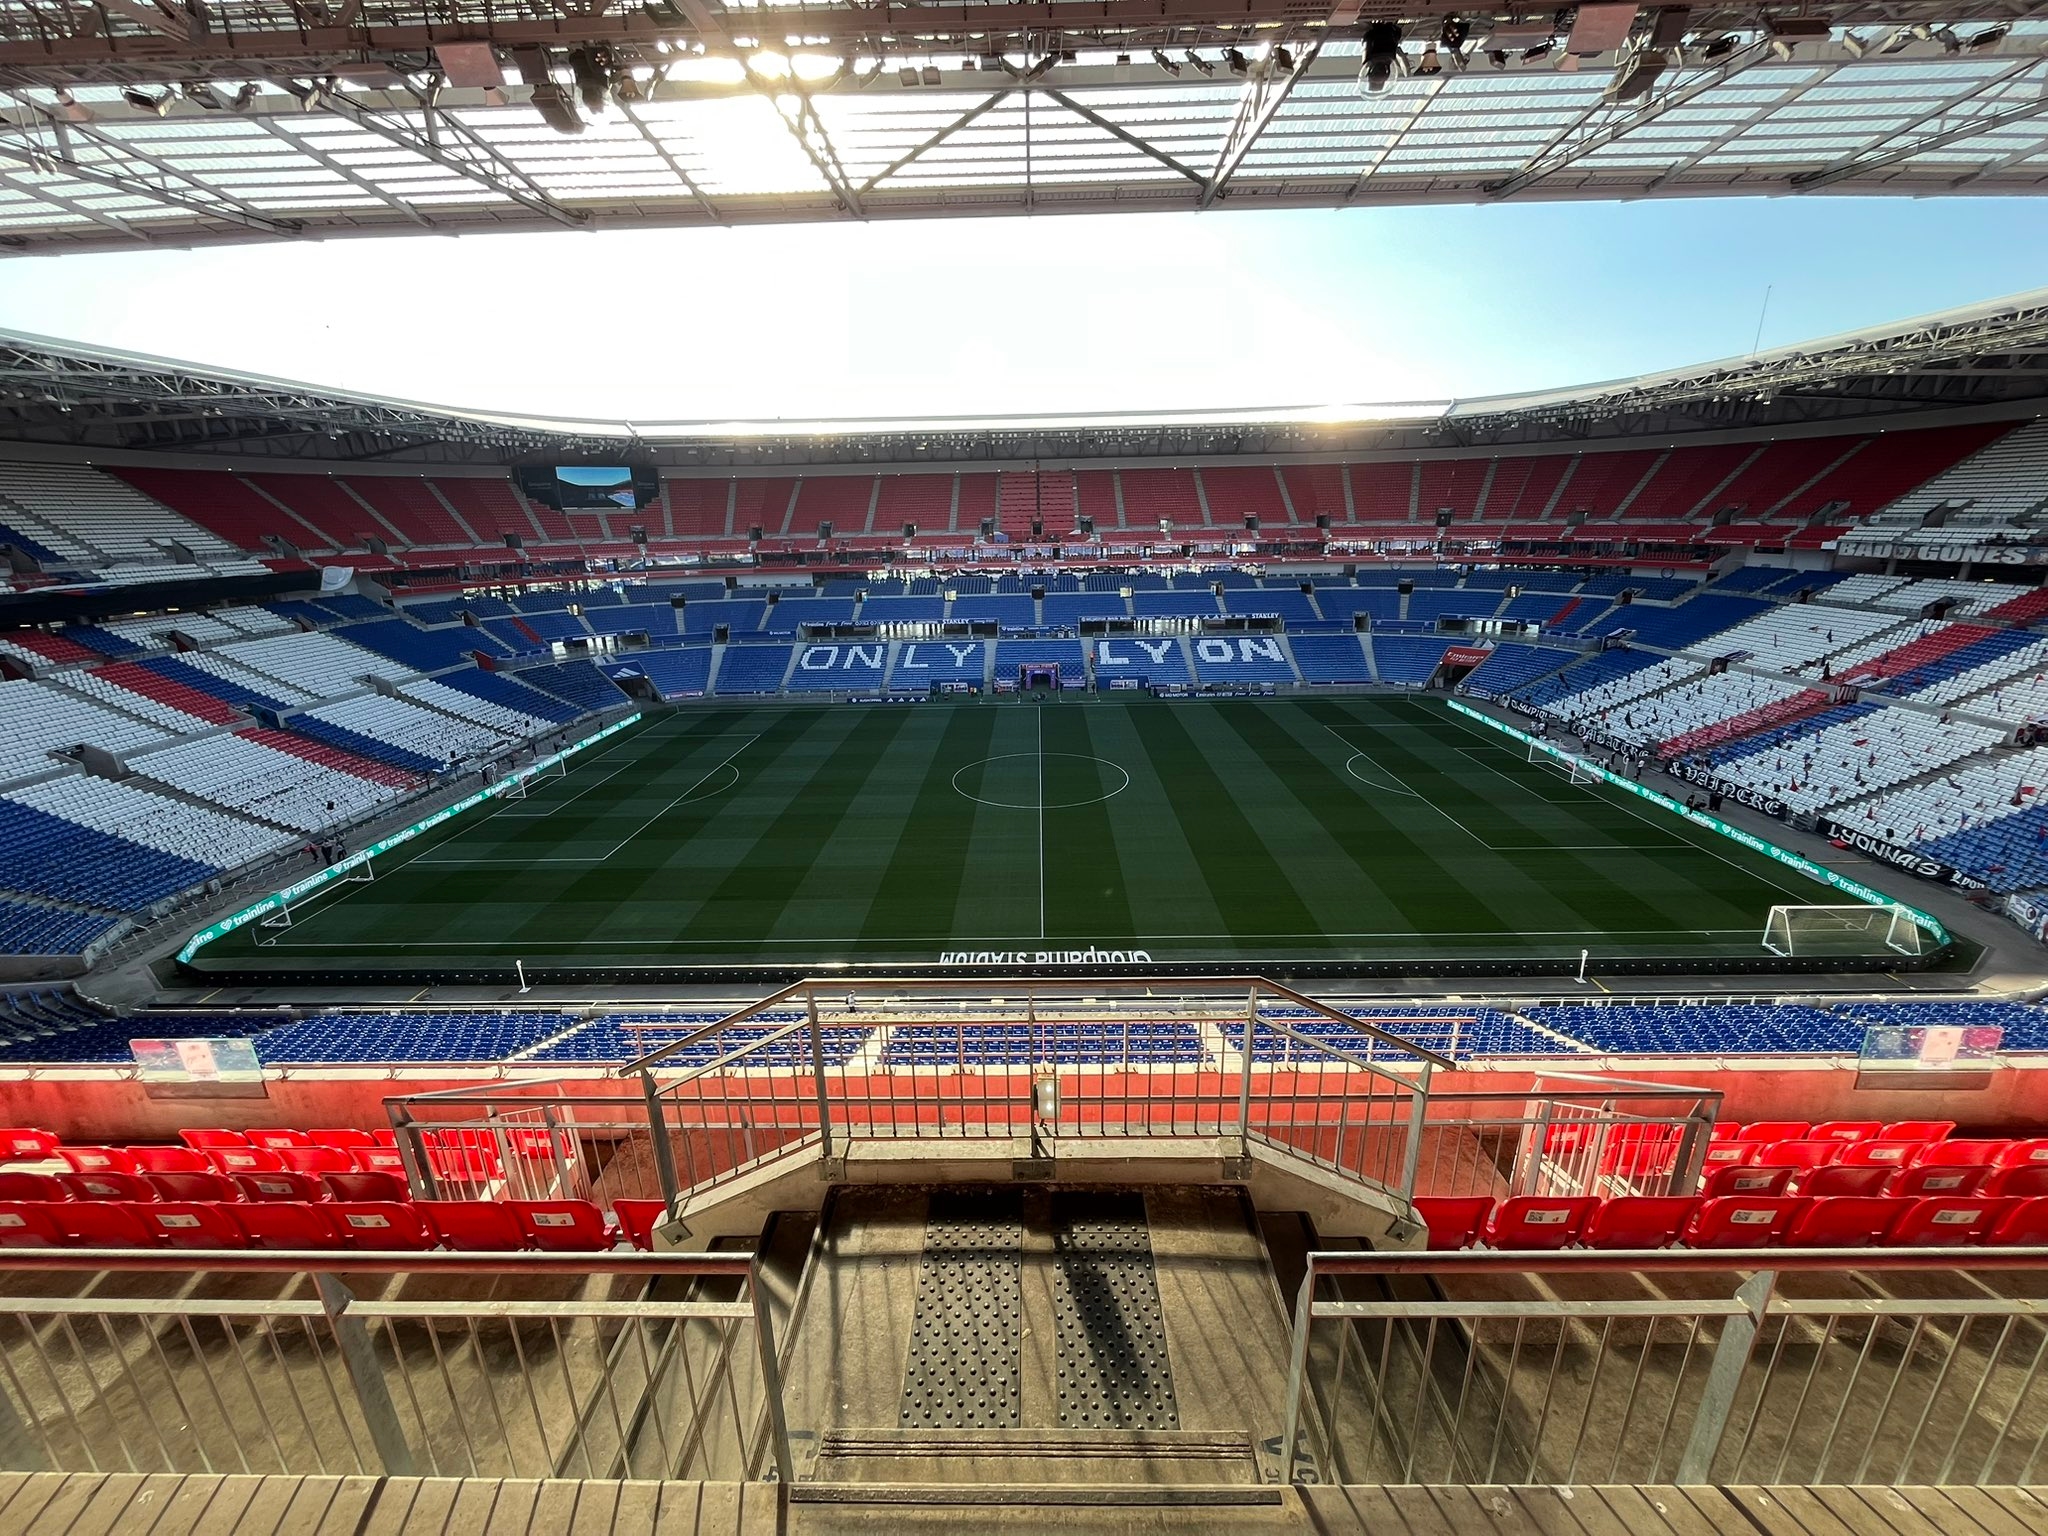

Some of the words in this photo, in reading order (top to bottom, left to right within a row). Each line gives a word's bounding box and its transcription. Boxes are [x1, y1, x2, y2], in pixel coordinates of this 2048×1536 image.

[1838, 541, 1892, 558] BAD
[1917, 545, 2028, 565] GONES
[801, 644, 976, 670] ONLY
[1099, 638, 1284, 664] LYON
[1447, 651, 1484, 660] Emirates
[1649, 792, 1675, 810] trainline
[426, 811, 451, 828] trainline
[387, 829, 415, 847] trainline
[1730, 829, 1764, 851] trainline
[1827, 824, 1941, 876] LYONNAIS
[1780, 853, 1819, 875] trainline
[292, 873, 328, 895] trainline
[1839, 877, 1884, 904] trainline
[233, 900, 275, 926] trainline
[939, 951, 1027, 963] STADIUM
[1036, 945, 1152, 963] Groupama
